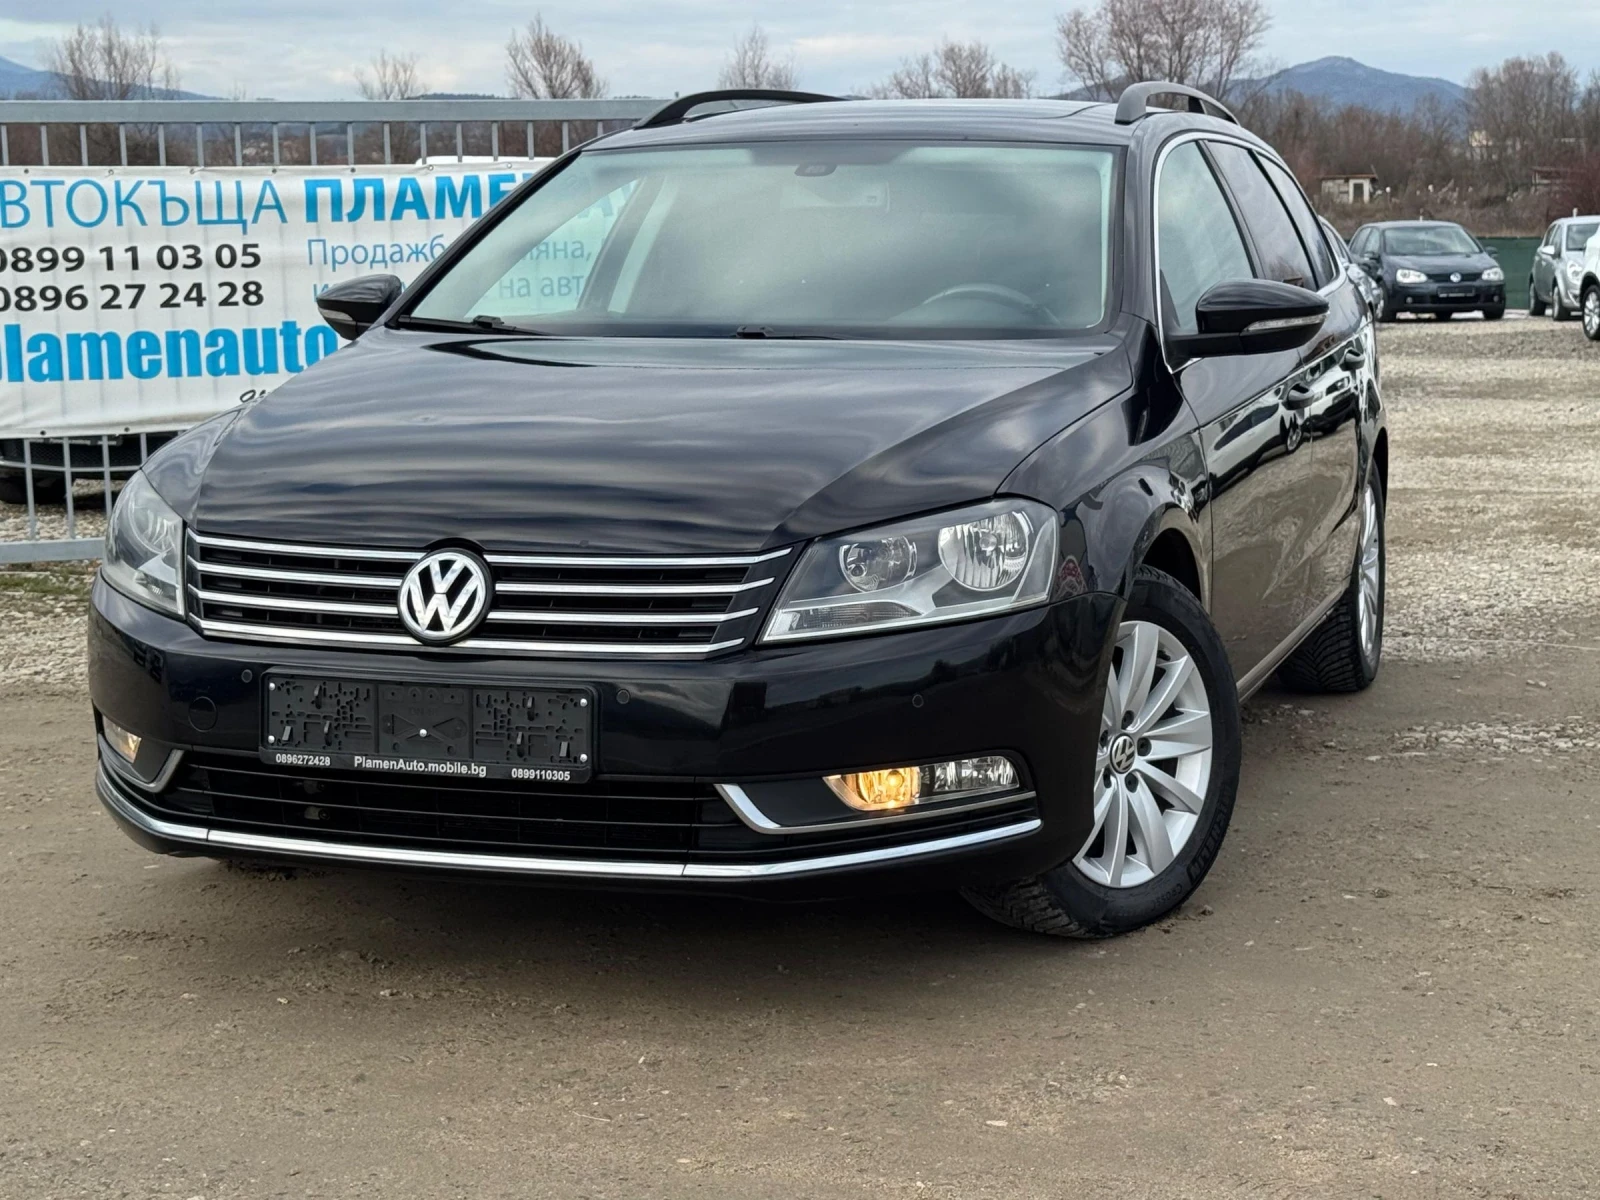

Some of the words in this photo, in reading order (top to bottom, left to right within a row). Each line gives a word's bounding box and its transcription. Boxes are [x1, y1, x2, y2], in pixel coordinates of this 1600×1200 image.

[304, 173, 534, 223] ПЛАМЕ
[99, 246, 140, 271] 11
[156, 245, 203, 270] 03
[215, 243, 262, 269] 05
[100, 284, 147, 310] 27
[159, 282, 207, 308] 24
[217, 281, 265, 307] 28
[0, 320, 339, 383] lamenauto
[275, 753, 332, 767] 0896272428
[354, 755, 487, 778] PlamenAuto.mobile.bg
[511, 768, 571, 781] 0899110305
